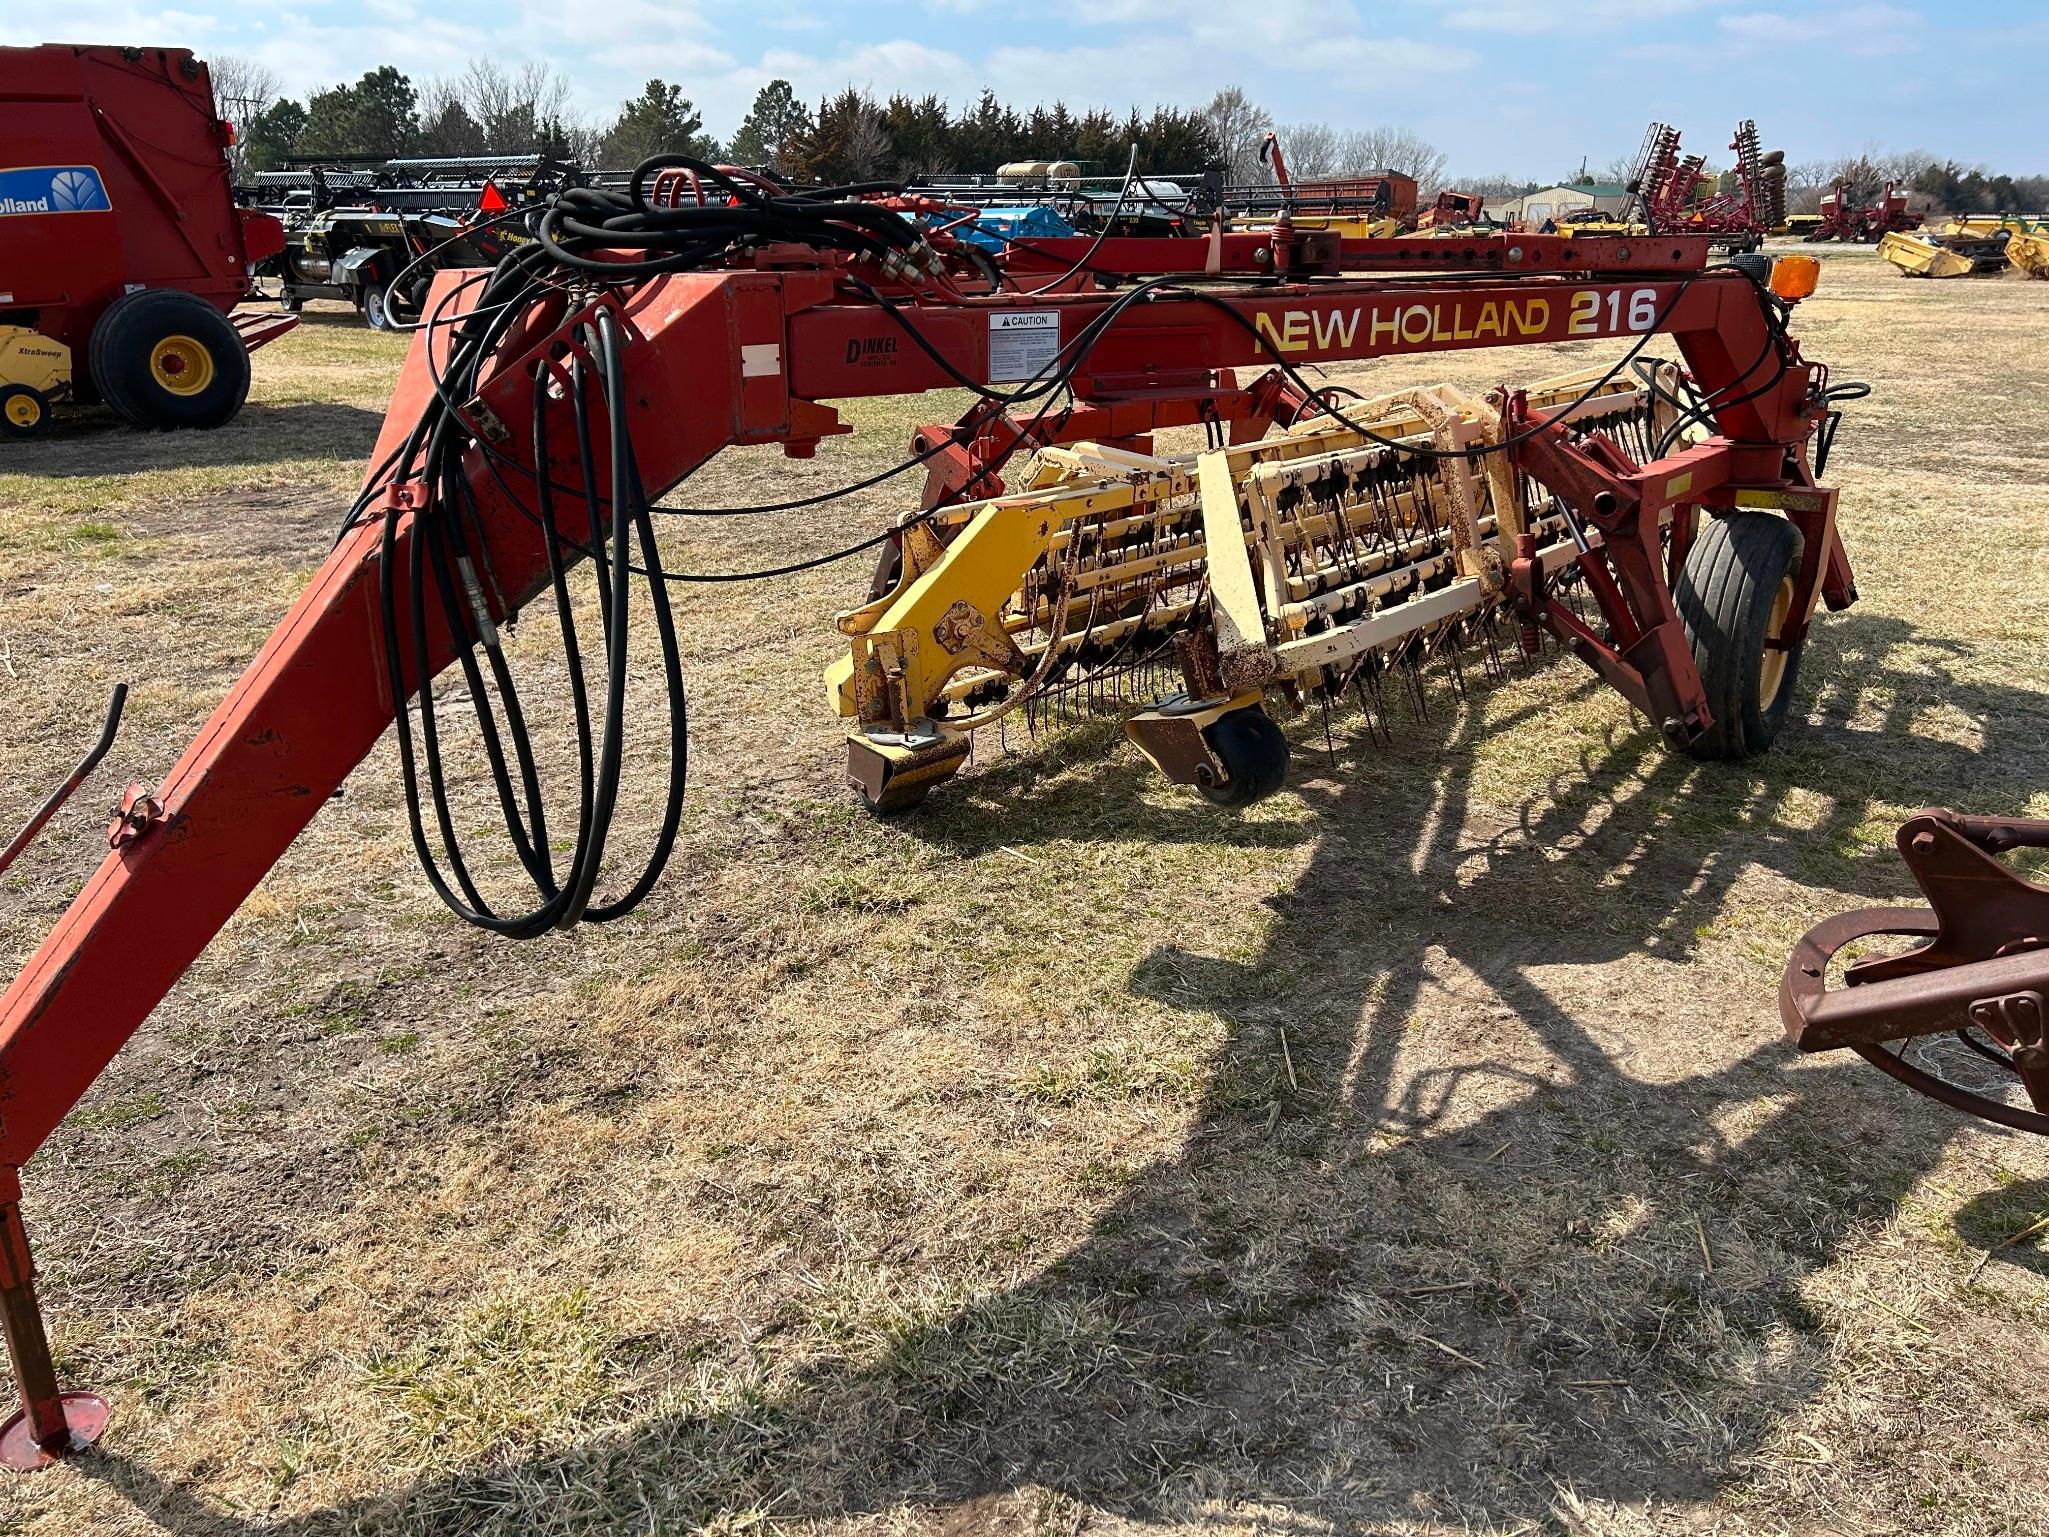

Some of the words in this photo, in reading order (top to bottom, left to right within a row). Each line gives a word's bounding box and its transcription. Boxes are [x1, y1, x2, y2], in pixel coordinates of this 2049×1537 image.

[1011, 315, 1048, 326] CAUTION
[1254, 307, 1361, 354] NEW
[1369, 298, 1550, 346] HOLLAND
[1568, 288, 1657, 335] 216
[18, 347, 62, 359] XtraSweep
[846, 336, 898, 364] DINKEL
